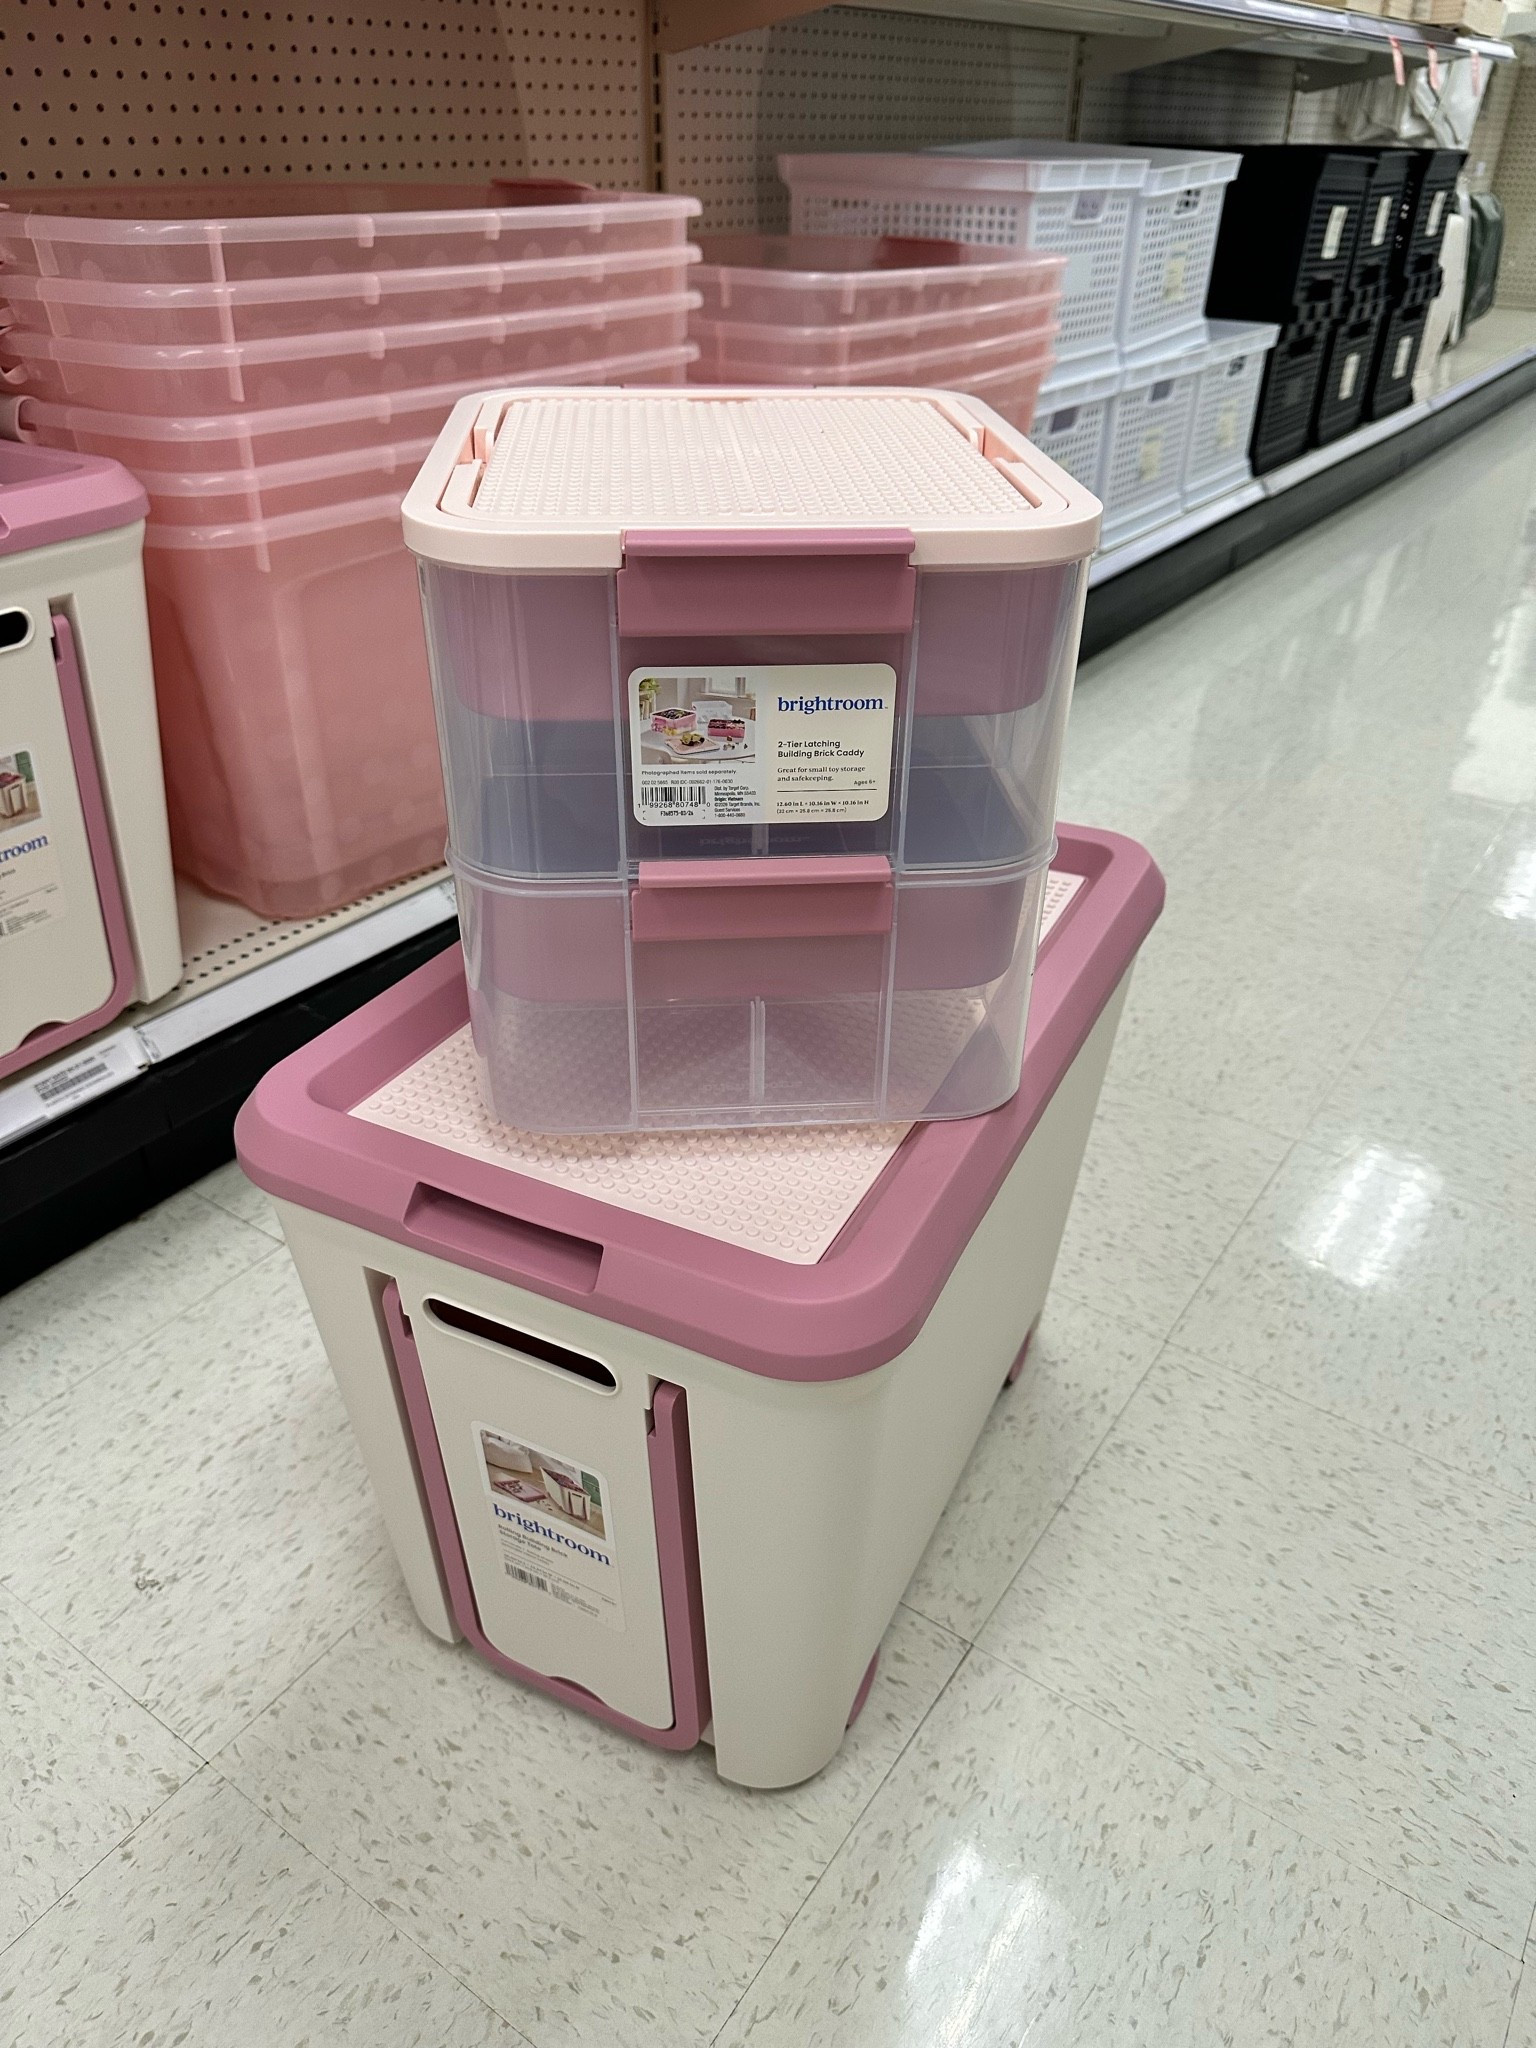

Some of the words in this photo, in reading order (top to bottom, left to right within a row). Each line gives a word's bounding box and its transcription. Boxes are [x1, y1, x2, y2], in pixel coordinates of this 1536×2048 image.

[777, 696, 884, 715] brightroom
[778, 740, 803, 748] 2-Tier
[804, 740, 841, 749] Latching
[777, 750, 812, 759] Building
[813, 749, 835, 757] Brick
[836, 749, 865, 758] Caddy
[828, 766, 839, 774] toy
[791, 775, 834, 783] safekeeping.
[493, 1502, 611, 1567] brightroom
